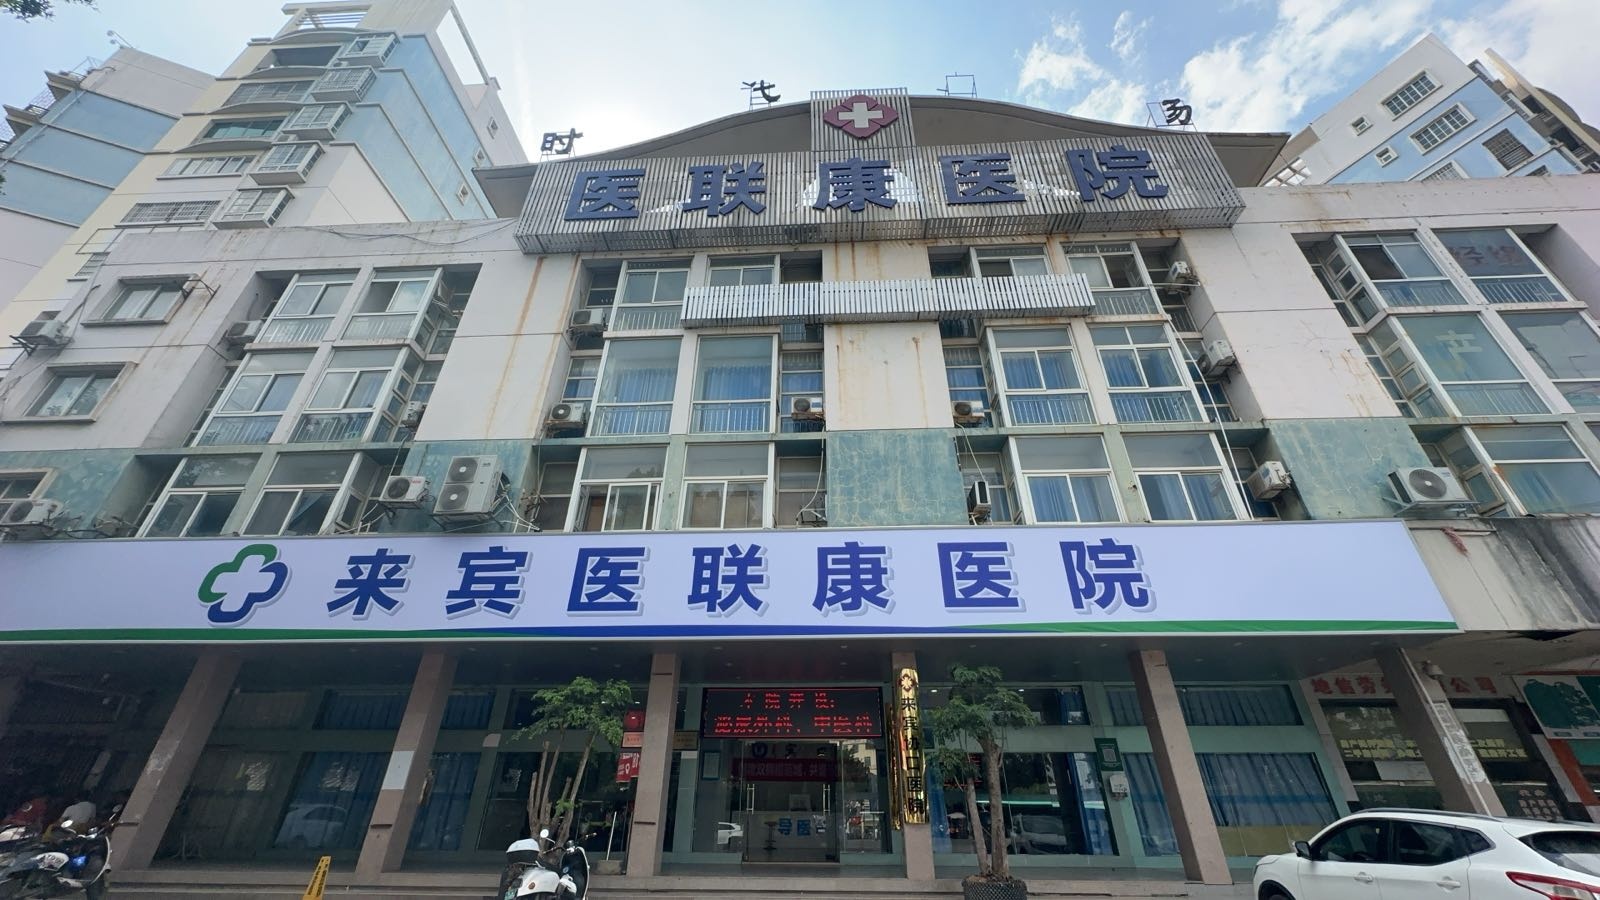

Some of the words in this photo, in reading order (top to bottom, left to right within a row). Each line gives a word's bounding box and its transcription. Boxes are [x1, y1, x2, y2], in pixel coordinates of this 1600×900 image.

[564, 144, 1169, 220] 医联康医院
[327, 538, 1153, 618] 来宾医联康医院
